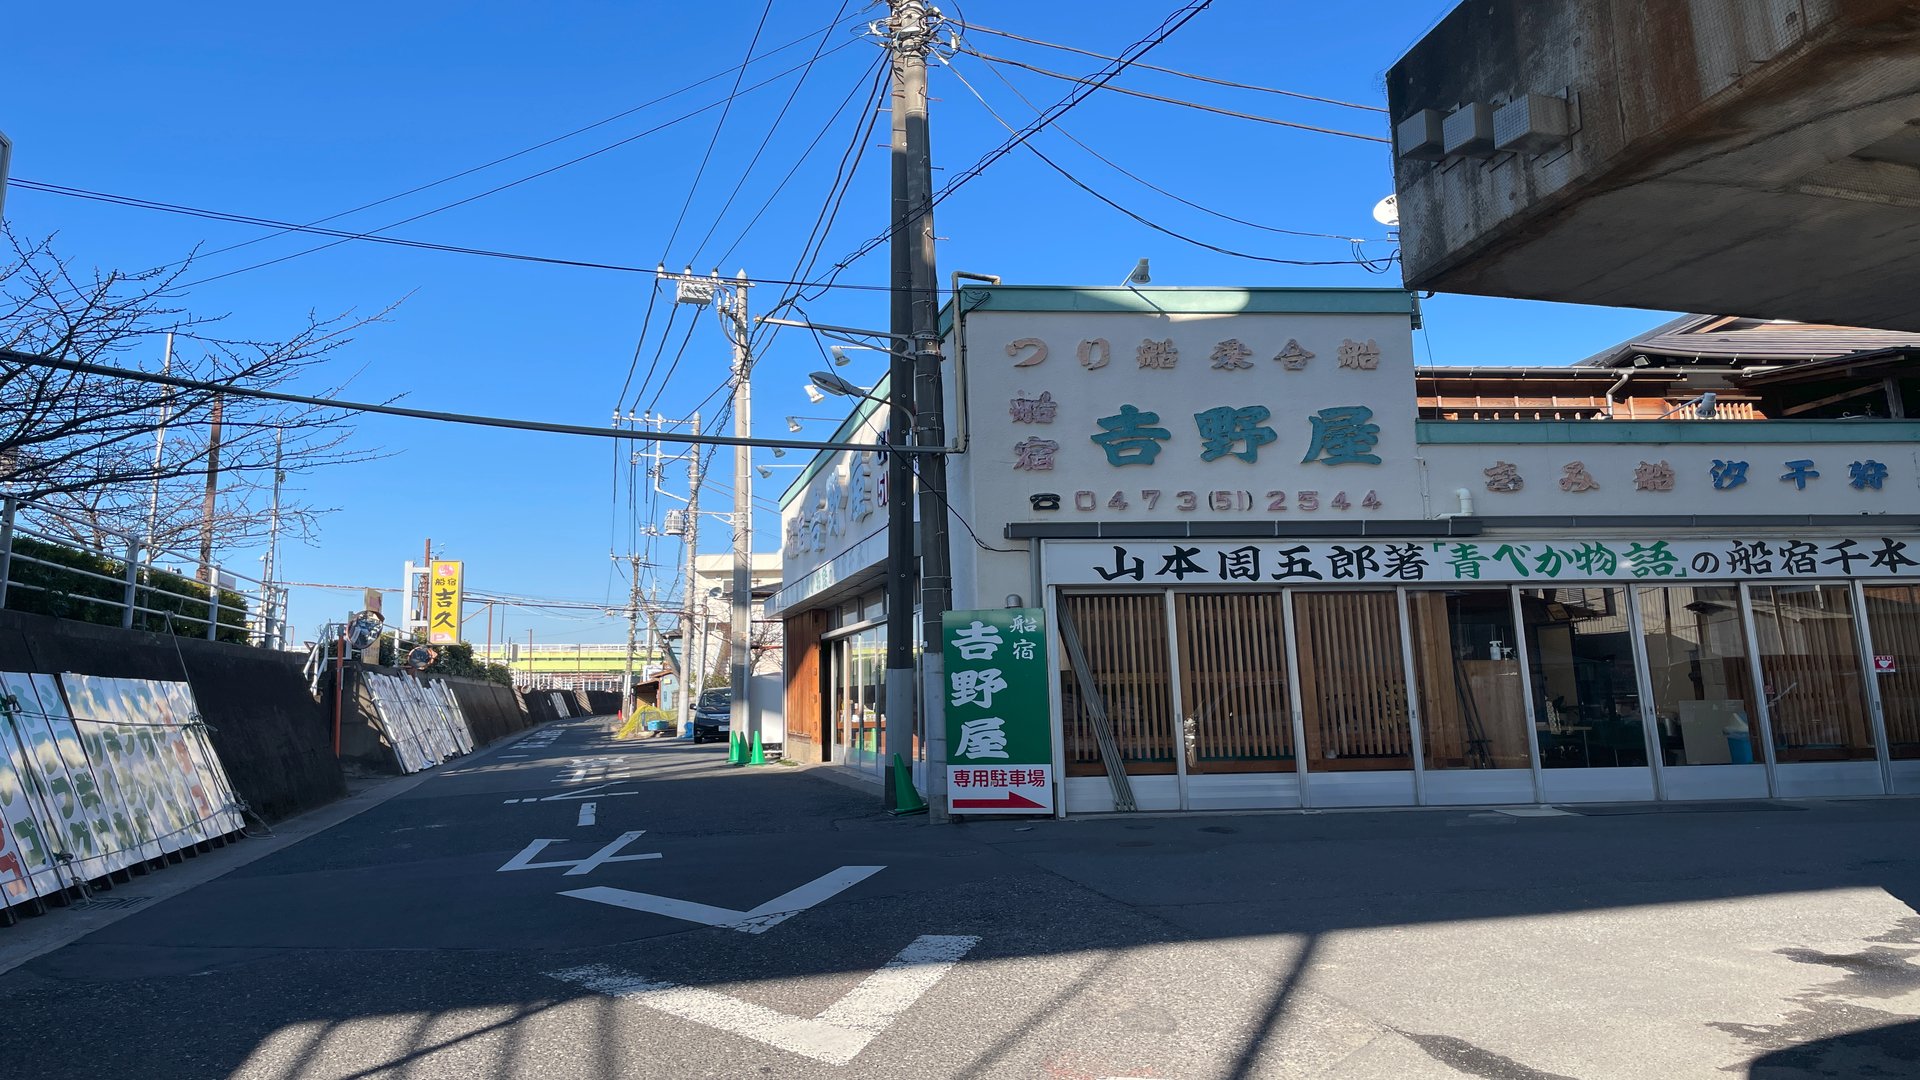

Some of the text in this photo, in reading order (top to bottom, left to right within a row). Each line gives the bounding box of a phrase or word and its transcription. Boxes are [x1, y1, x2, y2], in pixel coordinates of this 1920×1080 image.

[1090, 404, 1382, 467] 吉野屋
[434, 578, 457, 586] 船宿
[432, 588, 456, 628] 吉久
[1009, 614, 1038, 660] 船宿
[951, 620, 1009, 759] 吉野屋
[953, 769, 1046, 788] 専用駐車場
